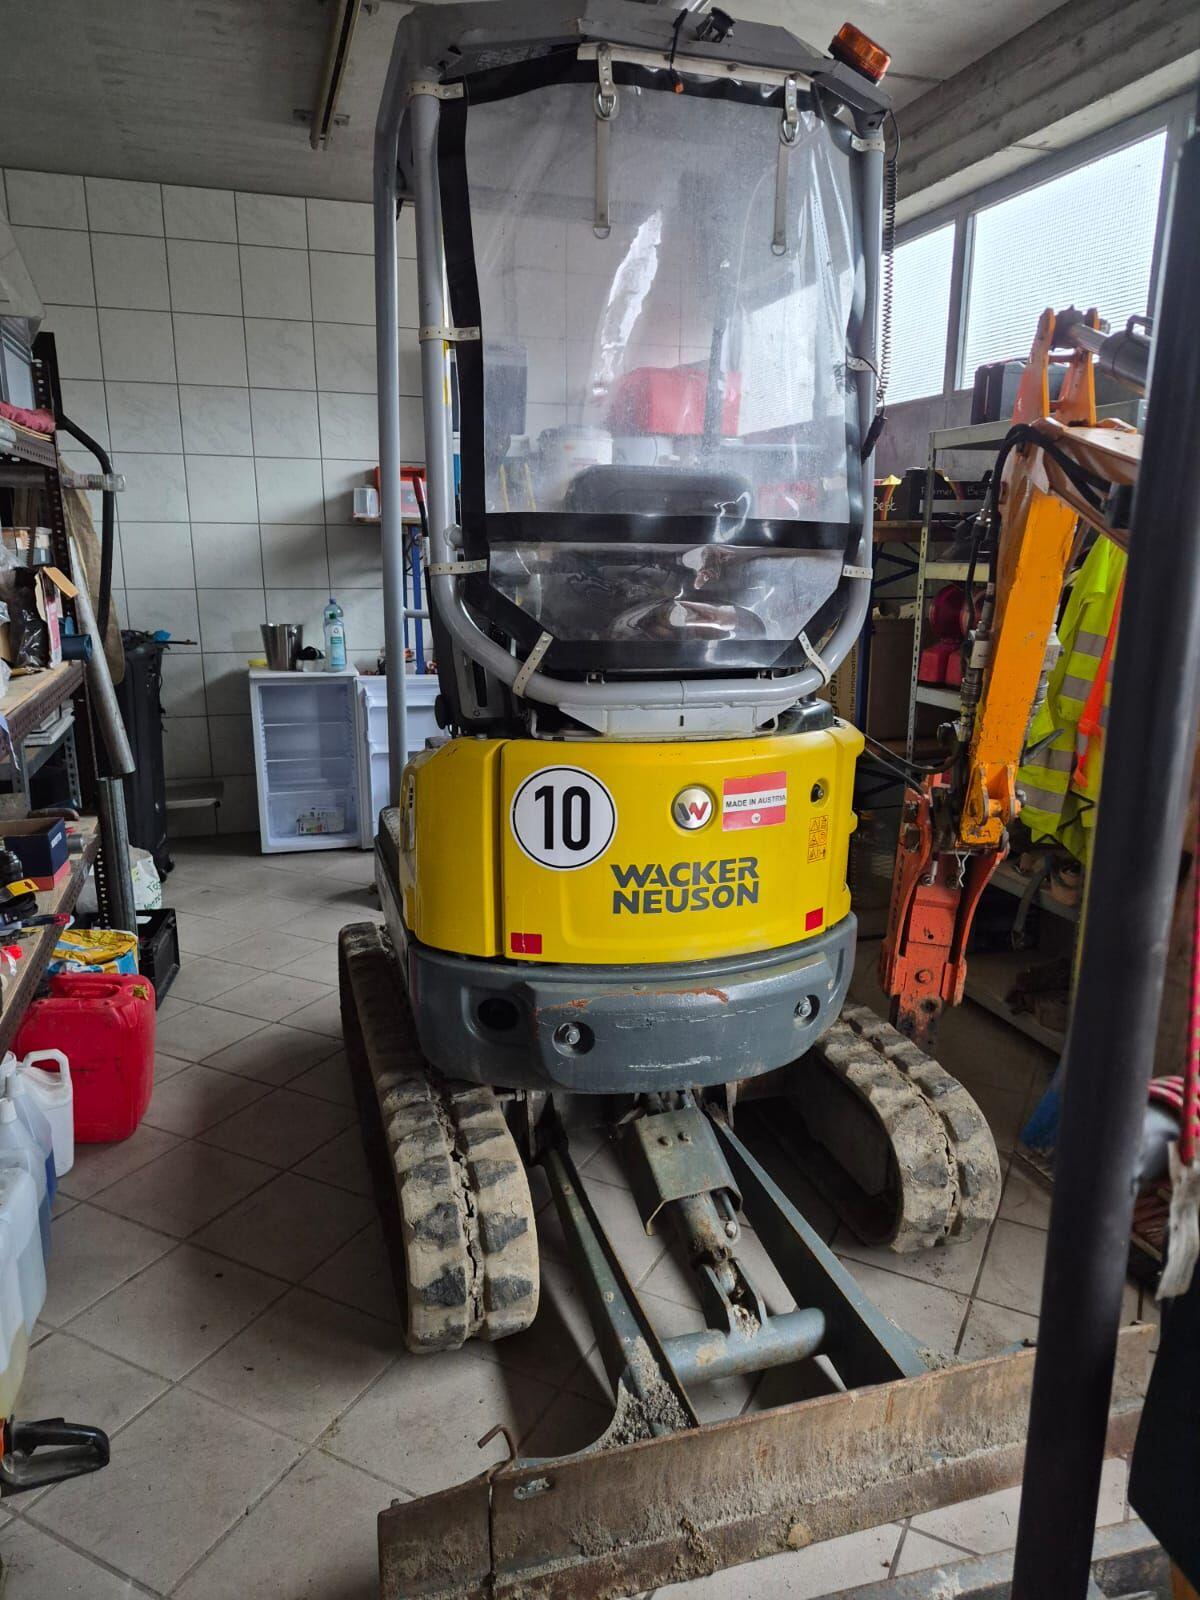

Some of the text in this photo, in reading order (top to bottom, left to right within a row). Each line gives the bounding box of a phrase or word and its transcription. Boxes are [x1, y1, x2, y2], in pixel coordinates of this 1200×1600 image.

[725, 800, 747, 808] MADE
[758, 795, 786, 804] AUSTRIA
[535, 786, 590, 851] 10
[610, 857, 759, 888] WACKER
[612, 881, 759, 914] NEUSON
